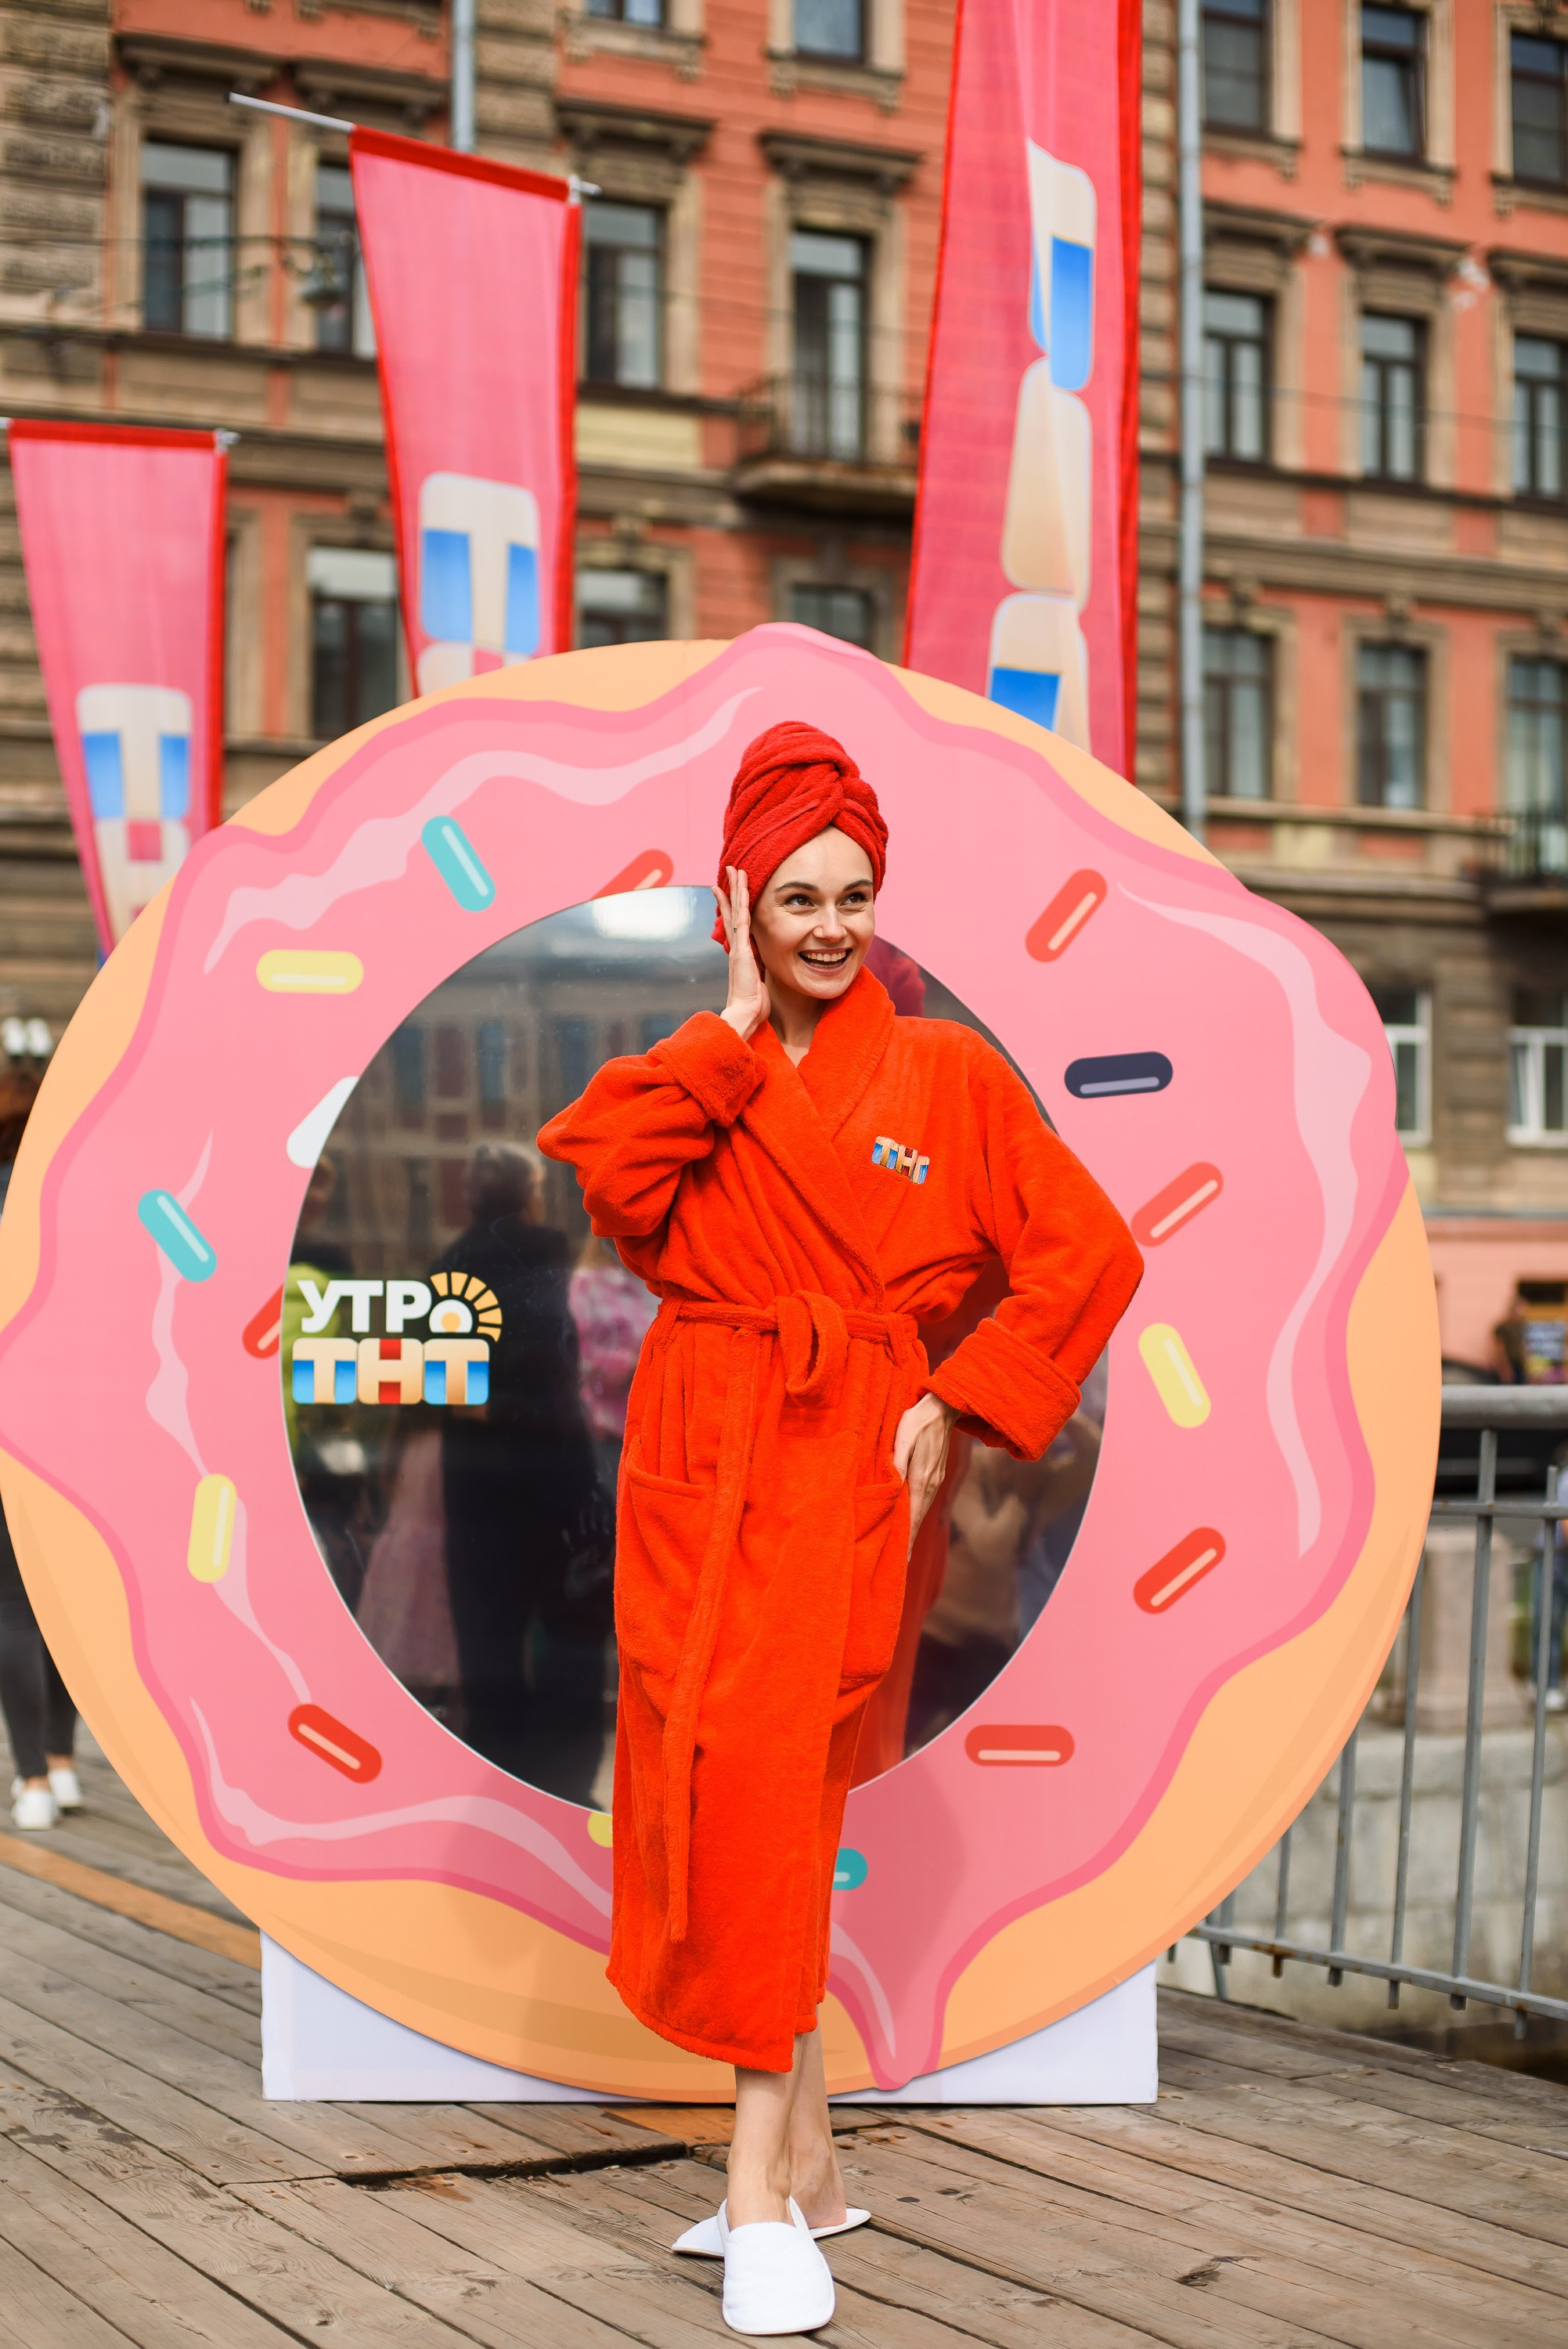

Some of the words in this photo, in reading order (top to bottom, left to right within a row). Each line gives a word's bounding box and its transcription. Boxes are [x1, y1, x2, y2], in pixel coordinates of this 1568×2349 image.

[871, 1135, 930, 1185] ТНТ
[297, 1279, 474, 1333] УТРО
[292, 1337, 490, 1405] ТНТ
